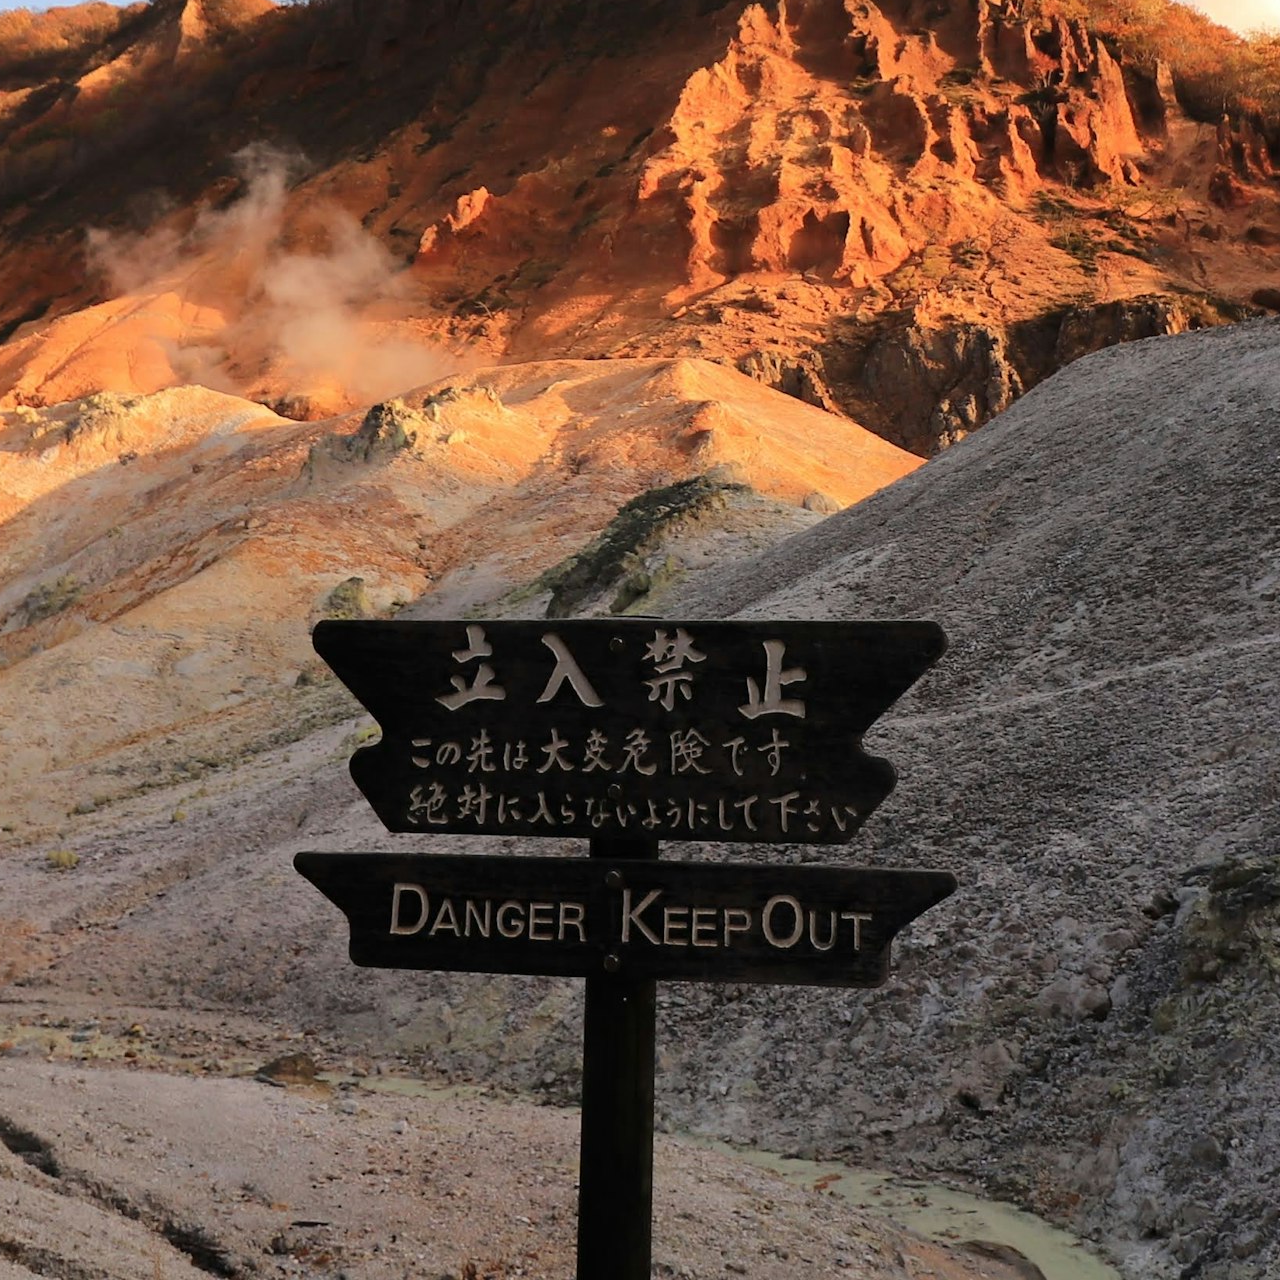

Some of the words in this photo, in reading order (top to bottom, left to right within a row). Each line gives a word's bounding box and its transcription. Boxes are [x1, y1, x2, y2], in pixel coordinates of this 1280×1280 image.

[435, 623, 808, 719] 立入禁止
[410, 727, 790, 776] この先は大変危険です
[407, 782, 858, 832] 絶対に入らないようにして下さい
[390, 882, 587, 942] DANGER
